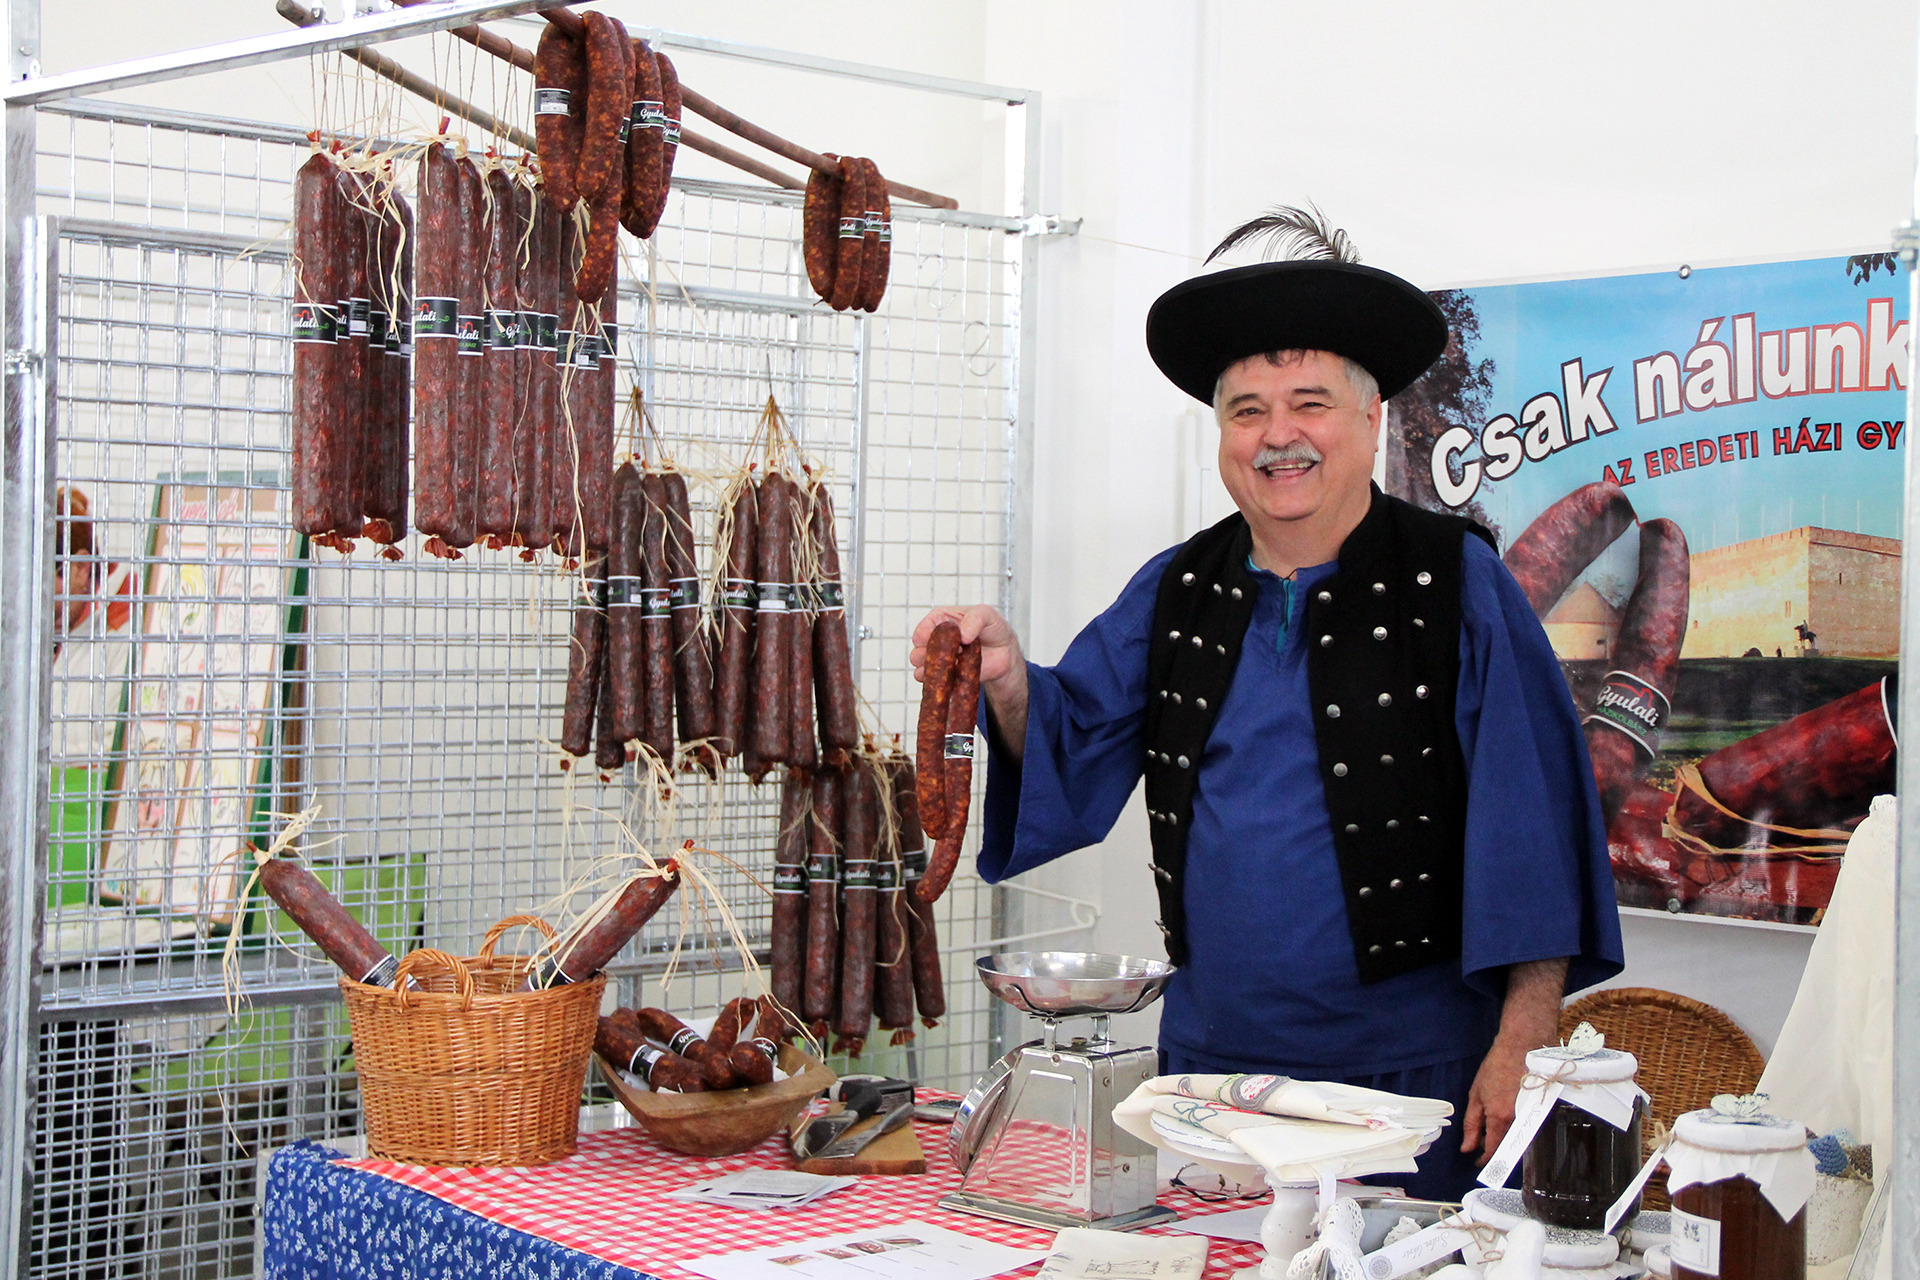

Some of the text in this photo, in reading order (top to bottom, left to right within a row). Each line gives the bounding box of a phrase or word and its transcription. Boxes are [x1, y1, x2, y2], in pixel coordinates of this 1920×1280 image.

[1431, 297, 1909, 508] Csak nálunk
[1603, 418, 1906, 487] AZ EREDETI HÁZI GY
[1597, 685, 1660, 727] Gyulali
